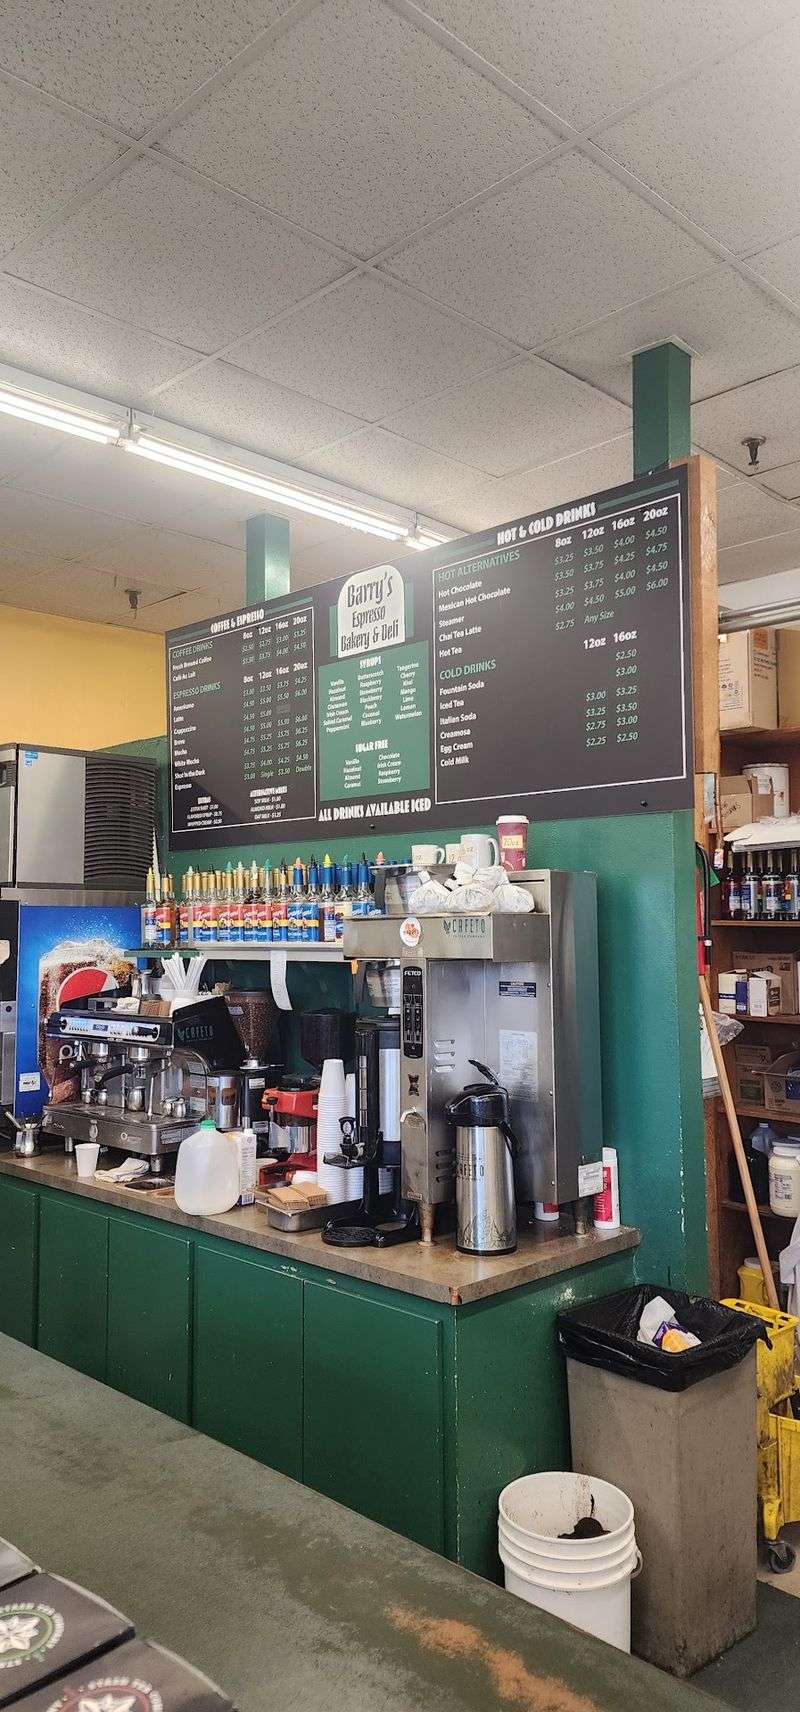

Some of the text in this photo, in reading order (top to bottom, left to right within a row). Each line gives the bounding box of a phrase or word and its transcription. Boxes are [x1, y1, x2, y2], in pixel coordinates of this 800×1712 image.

[497, 502, 596, 546] HOT & COLD DRINKS
[555, 506, 669, 548] 8oz 12oz 16oz 20oz
[438, 525, 668, 599] Hot Chocolate $3.25 $3.50 $4.00 $4.50
[438, 549, 520, 582] HOT ALTERNATIVES
[438, 542, 668, 612] Mexican Hot Chocolate $3.50 $3.75 $4.25 $4.75
[347, 571, 393, 608] Barry's
[439, 560, 668, 628] Steamer $3.25 $3.75 $4.00 $4.50
[210, 608, 265, 634] COFFEE & ESPRESSO
[352, 605, 385, 630] Espresso
[439, 577, 669, 642] Chai Tea Latte $4.00 $4.50 $5.00 $6.00
[258, 626, 272, 635] 12oz
[275, 621, 289, 630] 16oz
[293, 615, 308, 626] 20oz
[341, 619, 399, 652] Bakery & Deli
[439, 609, 615, 658] Hot Tea $2.75 Any Size
[172, 640, 213, 658] COFFEE DRINKS
[583, 630, 637, 649] 12oz 16oz
[243, 661, 308, 684] 8oz 12oz 16oz 20oz
[359, 655, 382, 669] SYRUPS
[396, 662, 419, 672] Tangerine
[439, 659, 497, 680] COLD DRINKS
[439, 649, 637, 696] Fountain Soda $2.50
[359, 679, 382, 688] Raspberry
[400, 671, 416, 680] Cherry
[439, 665, 637, 710] Iced Tea $3.00
[173, 681, 221, 700] ESPRESSO DRINKS
[359, 687, 383, 696] Strawberry
[400, 687, 416, 696] Mango
[402, 695, 414, 703] Lime
[394, 710, 423, 720] Watermelon
[400, 703, 417, 712] Lemon
[439, 685, 637, 725] Italian Soda $3.00 $3.25
[440, 702, 637, 739] Creamosa $3.25 $3.50
[355, 739, 389, 753] SUGAR FREE
[440, 715, 638, 754] Egg Cream $2.75 $3.00
[378, 752, 401, 761] Chocolate
[440, 732, 638, 767] Cold Milk $2.25 $2.50
[377, 776, 402, 785] Strawberry
[378, 768, 400, 777] Raspberry
[318, 797, 432, 822] ALL DRINKS AVAILABLE ICED
